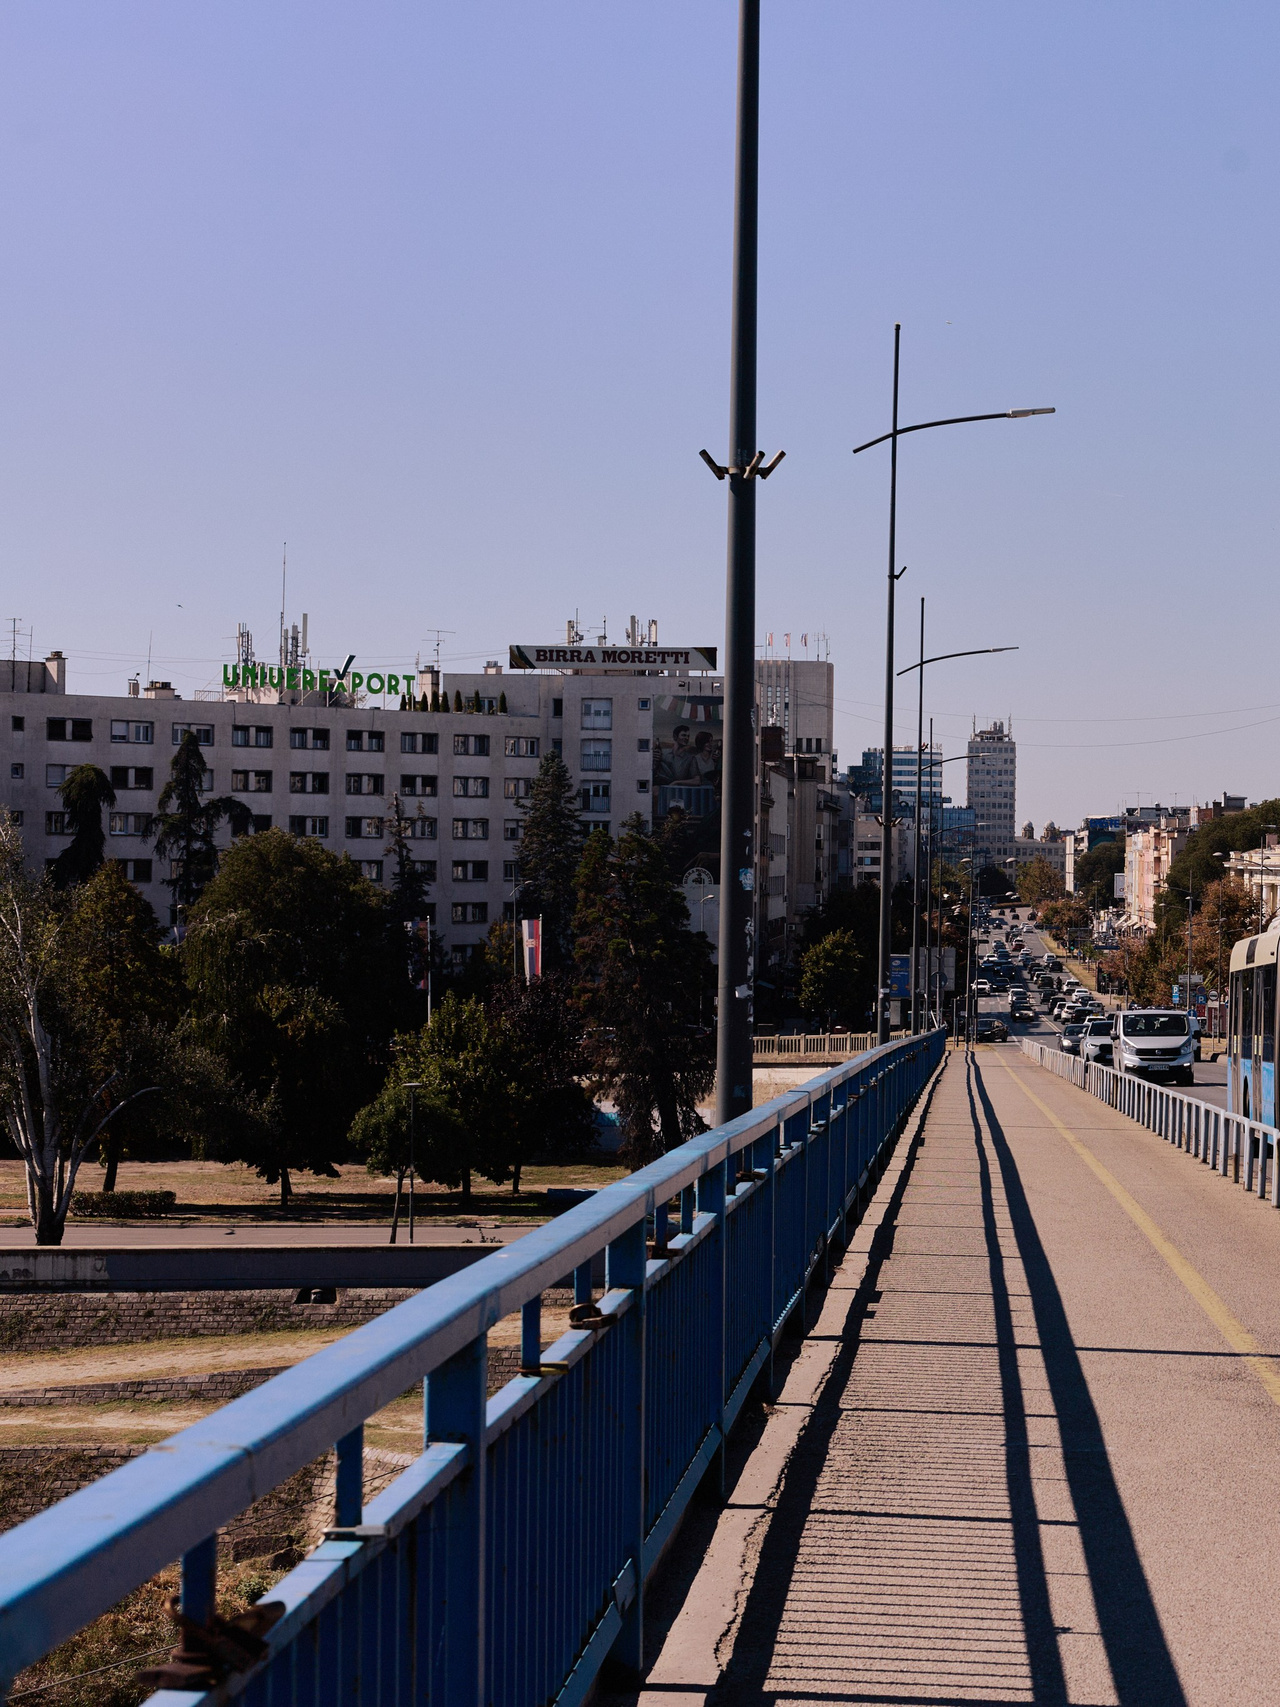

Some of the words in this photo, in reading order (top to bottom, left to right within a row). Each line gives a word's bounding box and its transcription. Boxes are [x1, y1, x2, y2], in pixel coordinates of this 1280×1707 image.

[535, 649, 596, 663] BIRRA
[601, 650, 690, 664] MORETTI
[222, 655, 415, 695] UNIVEREXPORT
